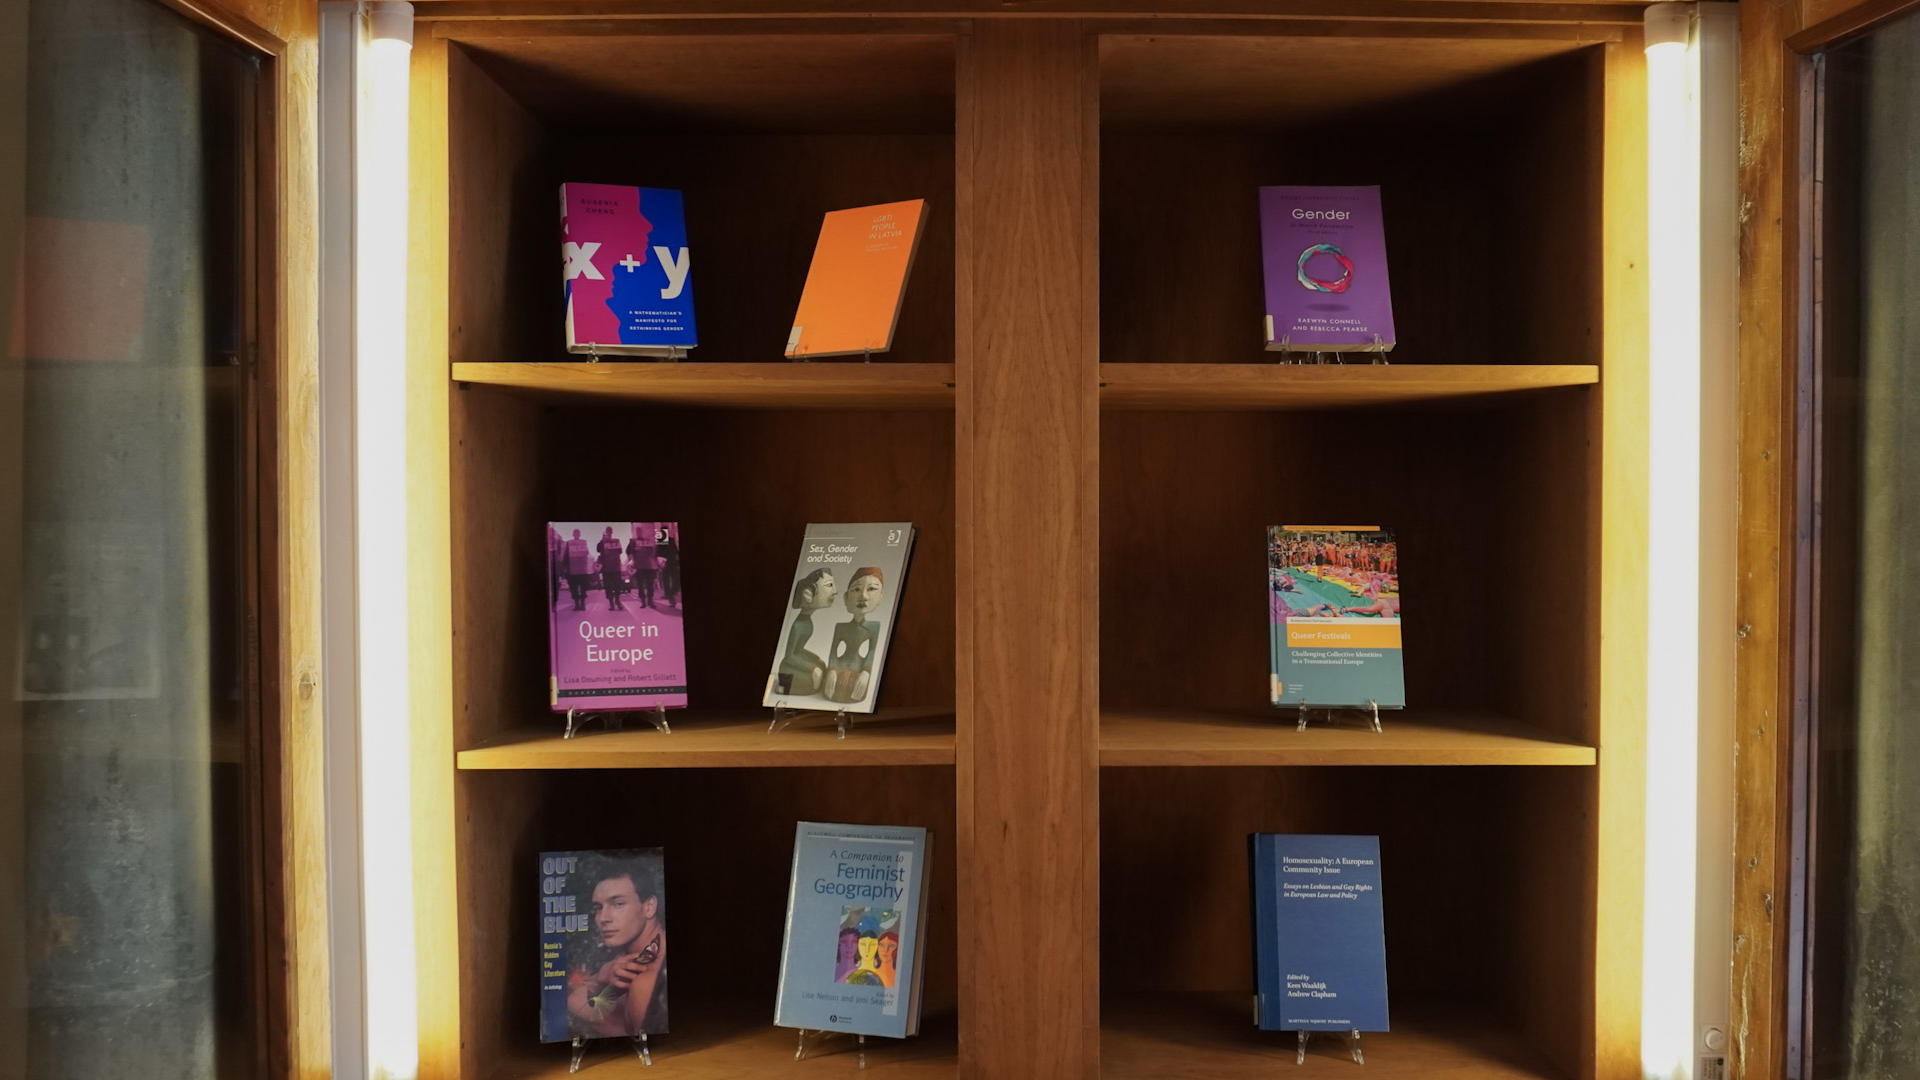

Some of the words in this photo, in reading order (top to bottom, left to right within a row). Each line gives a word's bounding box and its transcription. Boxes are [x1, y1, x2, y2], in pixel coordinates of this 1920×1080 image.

[1291, 208, 1350, 220] Gender
[562, 241, 606, 281] x
[653, 245, 691, 300] y
[809, 544, 825, 553] Sex,
[827, 544, 858, 553] Gender
[807, 554, 823, 563] and
[823, 554, 853, 564] Society
[579, 620, 635, 641] Queer
[641, 622, 658, 637] in
[1291, 632, 1315, 640] Queer
[1317, 632, 1351, 640] Festivals
[586, 644, 654, 665] Europe
[1291, 650, 1325, 659] Challenging
[1327, 650, 1354, 658] Collective
[1344, 659, 1364, 667] Europe
[830, 849, 837, 858] A
[840, 849, 892, 861] Companion
[895, 853, 904, 862] to
[1283, 856, 1334, 866] Homosexuality:
[1342, 857, 1374, 867] European
[543, 856, 578, 876] OUT
[837, 862, 905, 881] Feminist
[1283, 865, 1322, 875] Community
[1323, 866, 1341, 874] Issue
[543, 876, 566, 895] OF
[814, 878, 904, 902] Geography
[1284, 883, 1302, 891] Essays
[1355, 883, 1373, 891] Rights
[1290, 892, 1317, 900] European
[1341, 892, 1358, 900] Policy
[543, 896, 577, 914] THE
[543, 914, 589, 934] BLUE
[1311, 991, 1337, 999] Clapham
